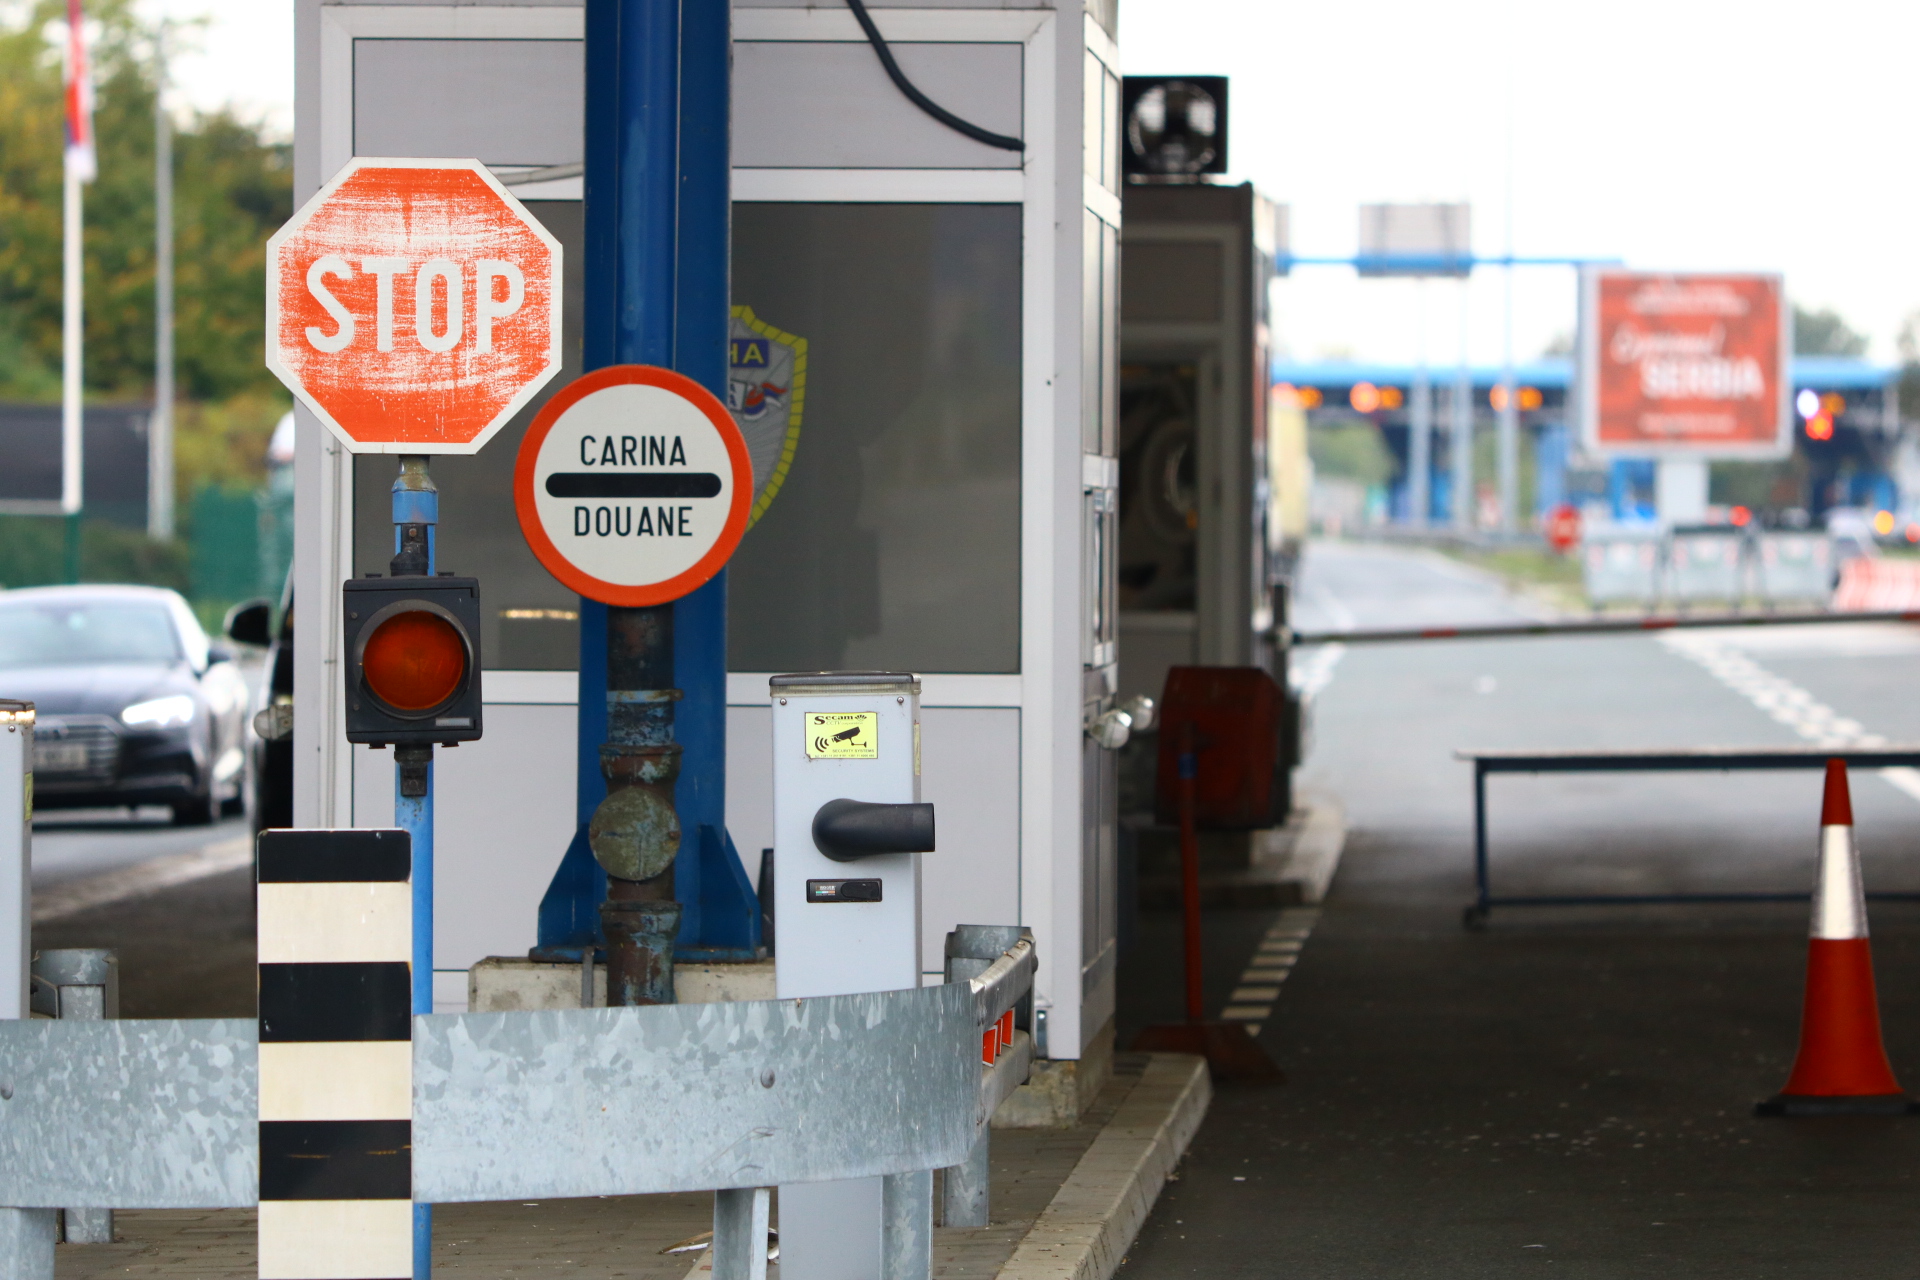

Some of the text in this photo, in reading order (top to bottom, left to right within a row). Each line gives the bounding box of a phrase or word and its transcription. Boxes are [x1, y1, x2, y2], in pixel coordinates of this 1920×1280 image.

[305, 255, 524, 353] STOP
[580, 435, 687, 466] CARINA
[574, 506, 693, 537] DOUANE
[814, 715, 853, 725] Secam
